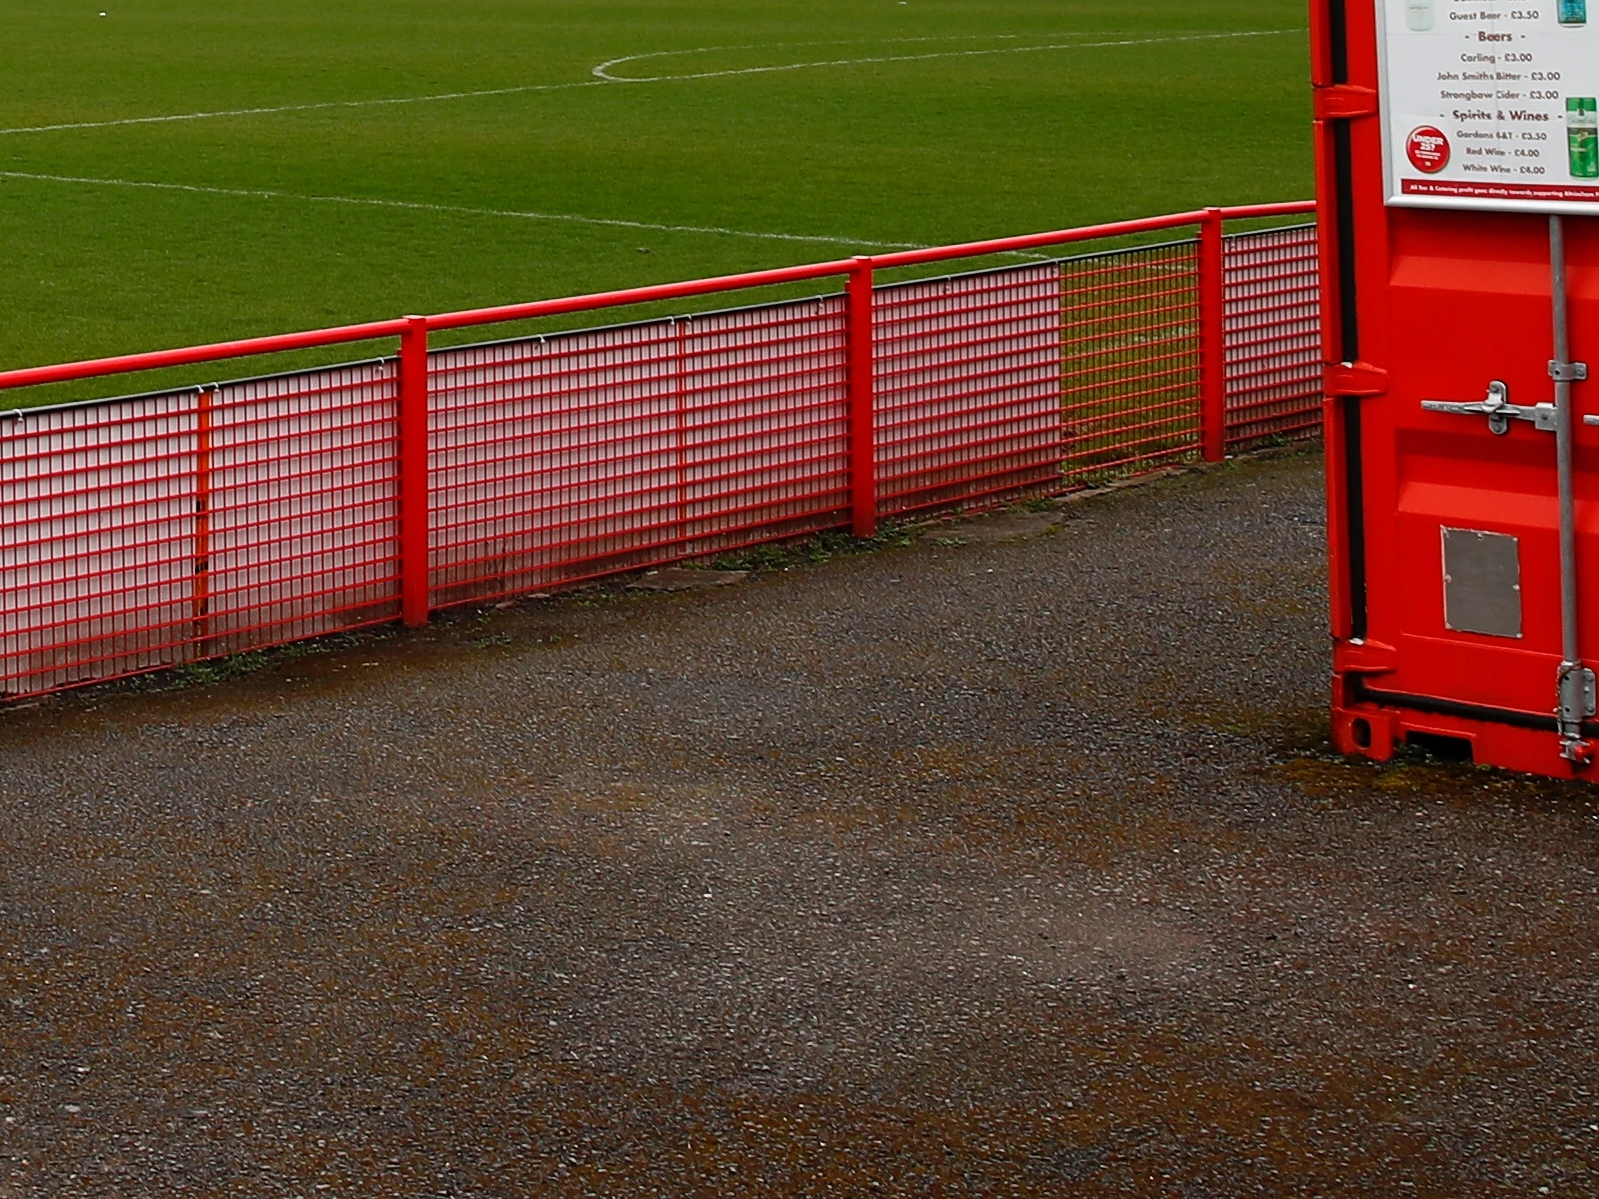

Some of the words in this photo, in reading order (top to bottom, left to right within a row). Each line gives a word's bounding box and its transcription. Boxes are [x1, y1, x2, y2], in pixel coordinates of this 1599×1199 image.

[1449, 11, 1477, 21] Guest
[1480, 11, 1501, 21] Beer
[1511, 10, 1539, 20] £3.50
[1478, 31, 1513, 42] Beers
[1460, 53, 1496, 64] Carling
[1504, 53, 1533, 63] £3.00
[1437, 72, 1459, 81] John
[1461, 72, 1494, 82] Smiths
[1496, 72, 1521, 81] Bitter
[1531, 71, 1561, 82] £3.00
[1440, 90, 1493, 102] Strongbow
[1496, 90, 1521, 100] Cider
[1529, 90, 1559, 100] £3.00
[1452, 110, 1492, 125] Spirits
[1496, 110, 1506, 121] &
[1509, 110, 1549, 122] Wines
[1412, 134, 1444, 145] UNDER
[1456, 131, 1494, 140] Gordons
[1521, 132, 1547, 141] £3.50
[1466, 147, 1482, 156] Red
[1484, 147, 1506, 157] Wine
[1514, 148, 1540, 158] £4.00
[1462, 163, 1487, 173] White
[1489, 164, 1512, 174] Wine
[1520, 165, 1545, 175] £4.00
[1533, 189, 1564, 199] supporting
